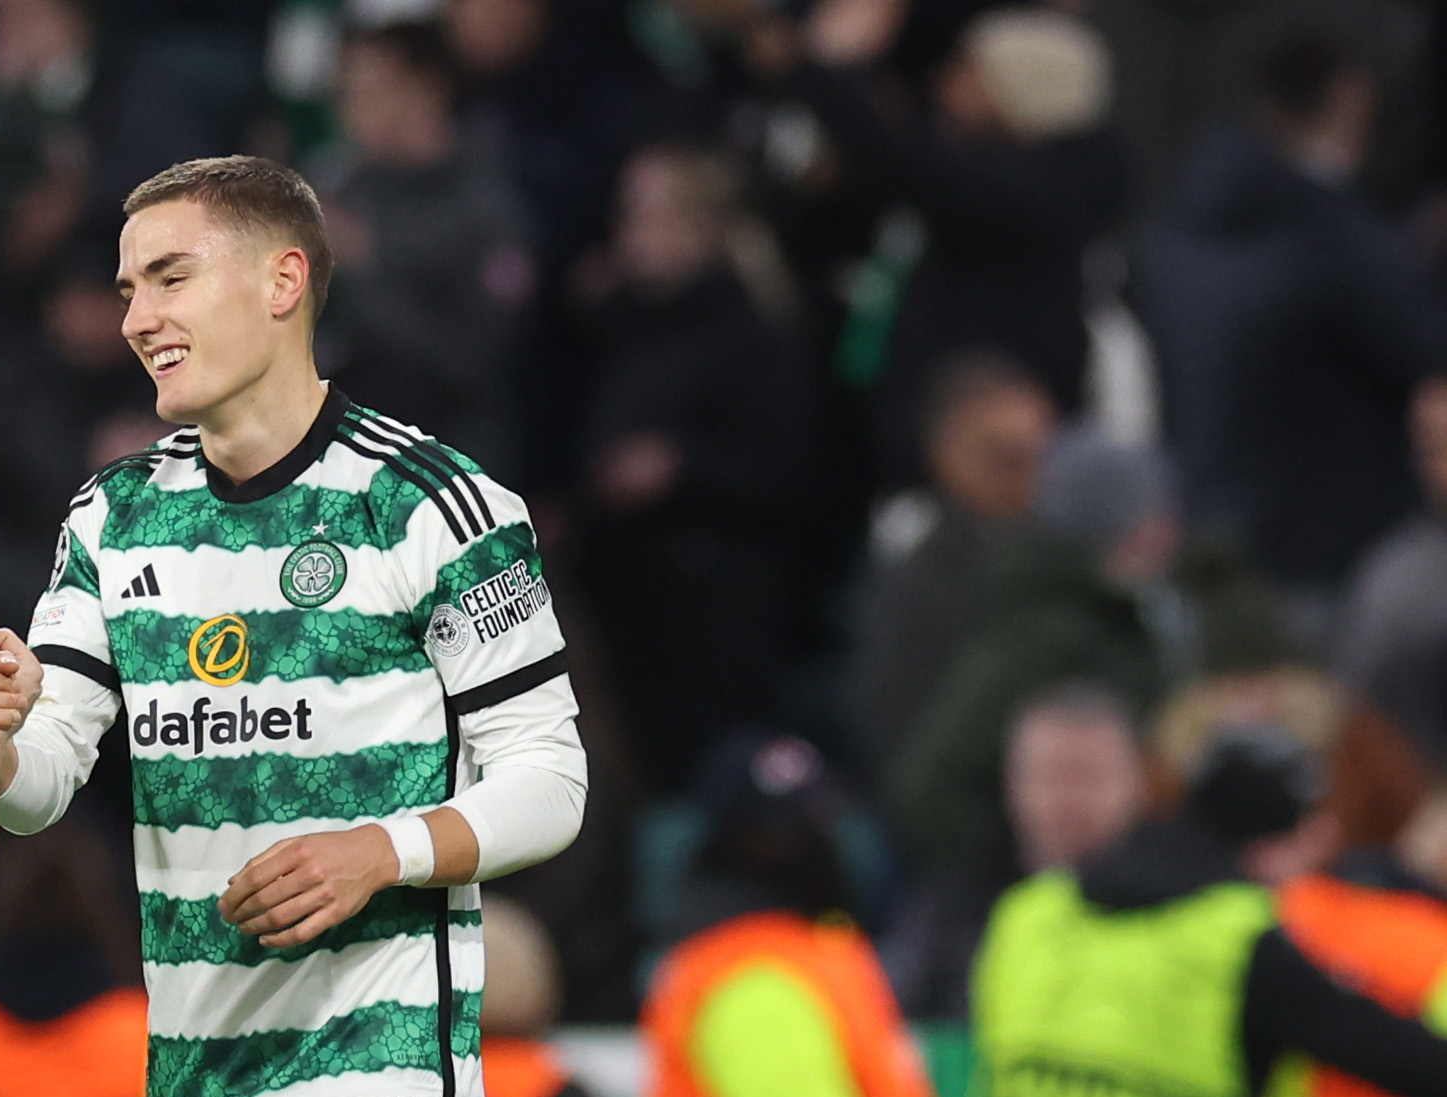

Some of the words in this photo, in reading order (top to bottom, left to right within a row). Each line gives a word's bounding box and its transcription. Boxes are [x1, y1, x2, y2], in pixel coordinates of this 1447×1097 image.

[462, 572, 516, 618] CELTIC
[513, 562, 531, 590] FC
[473, 576, 550, 644] FOUNDATION
[133, 695, 312, 755] dafabet
